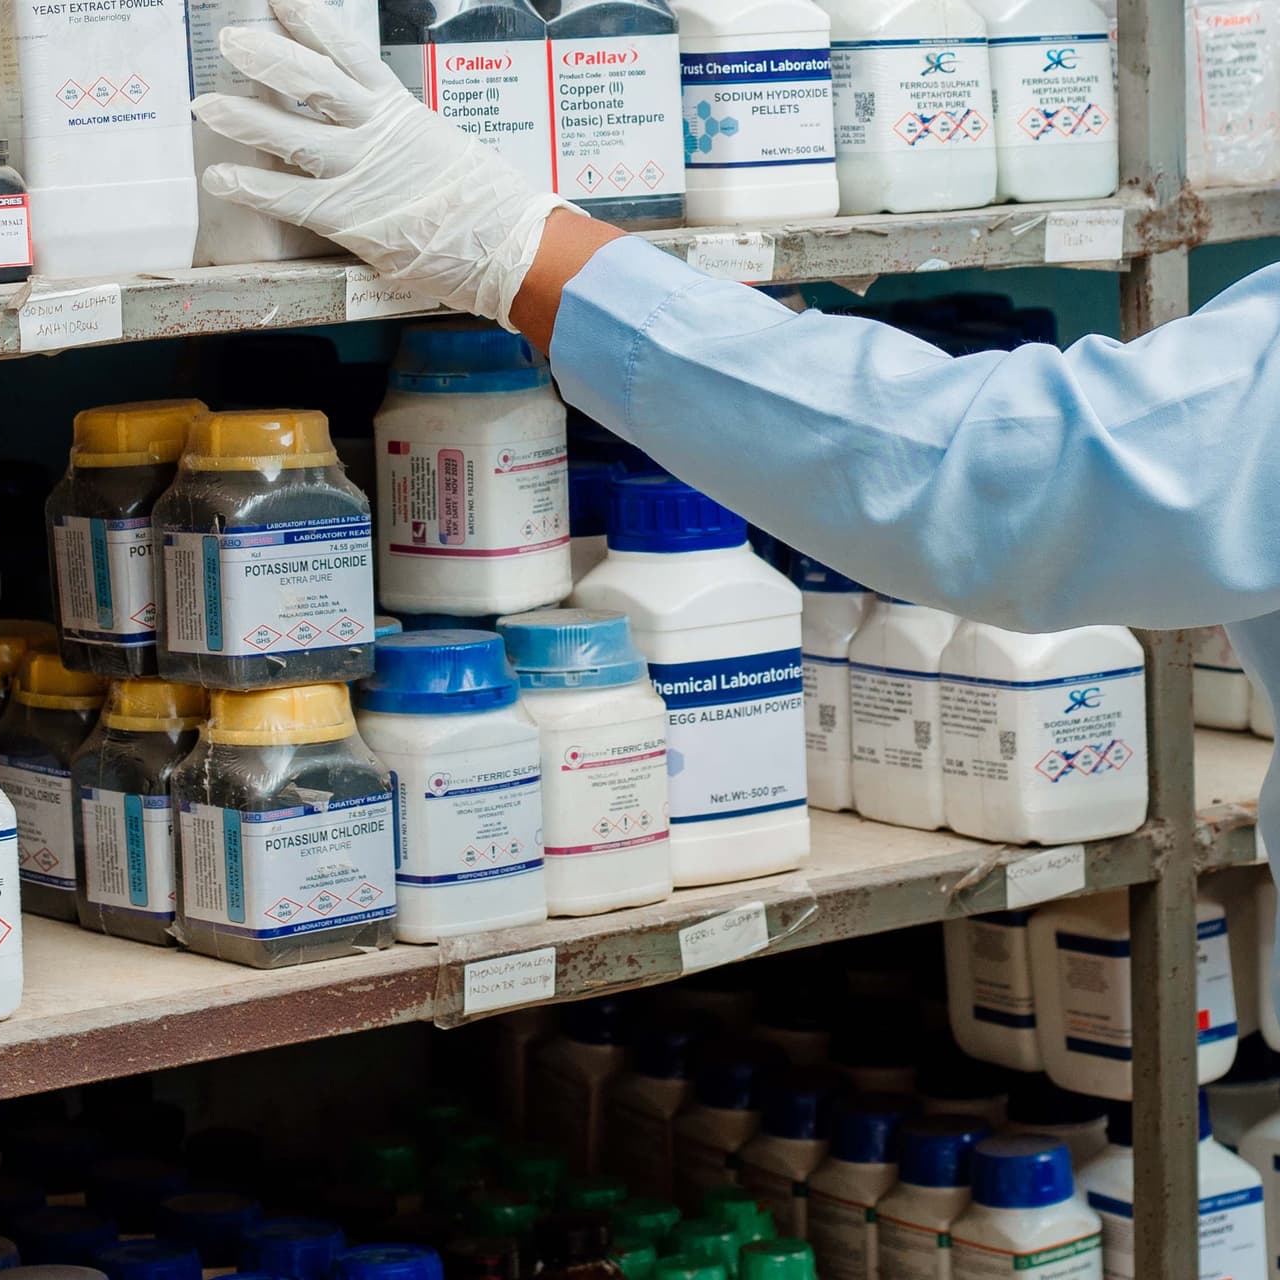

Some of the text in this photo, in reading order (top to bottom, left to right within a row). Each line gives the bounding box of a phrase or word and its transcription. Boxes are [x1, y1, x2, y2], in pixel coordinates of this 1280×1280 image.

[33, 3, 67, 16] YEAST
[69, 0, 111, 14] EXTRACT
[706, 59, 766, 75] Chemical
[900, 80, 980, 90] FERROUS SULPHATE
[1021, 75, 1099, 87] FERROUS SULPHATE
[443, 88, 500, 104] Copper (II)
[560, 82, 625, 99] Copper (II)
[714, 88, 829, 102] SODIUM HYDROXIDE
[910, 90, 972, 101] HEPTAHYDRATE
[1031, 85, 1092, 97] HEPTAHYDRATE
[444, 103, 500, 118] Carbonate
[561, 96, 625, 111] Carbonate
[751, 103, 800, 116] PELLETS
[68, 111, 157, 127] MOLATOM SCIENTIFIC
[484, 119, 535, 134] Extrapure
[561, 111, 665, 129] (basic) Extrapure
[244, 554, 367, 577] POTASSIUM CHLORIDE
[280, 572, 333, 586] EXTRA PURE
[653, 674, 717, 696] hemical
[669, 712, 695, 726] EGG
[698, 703, 761, 724] ALBANIUM
[1043, 712, 1123, 730] SODIUM ACETATE
[265, 820, 385, 852] POTASSIUM CHLORIDE
[300, 841, 352, 857] EXTRA PURE
